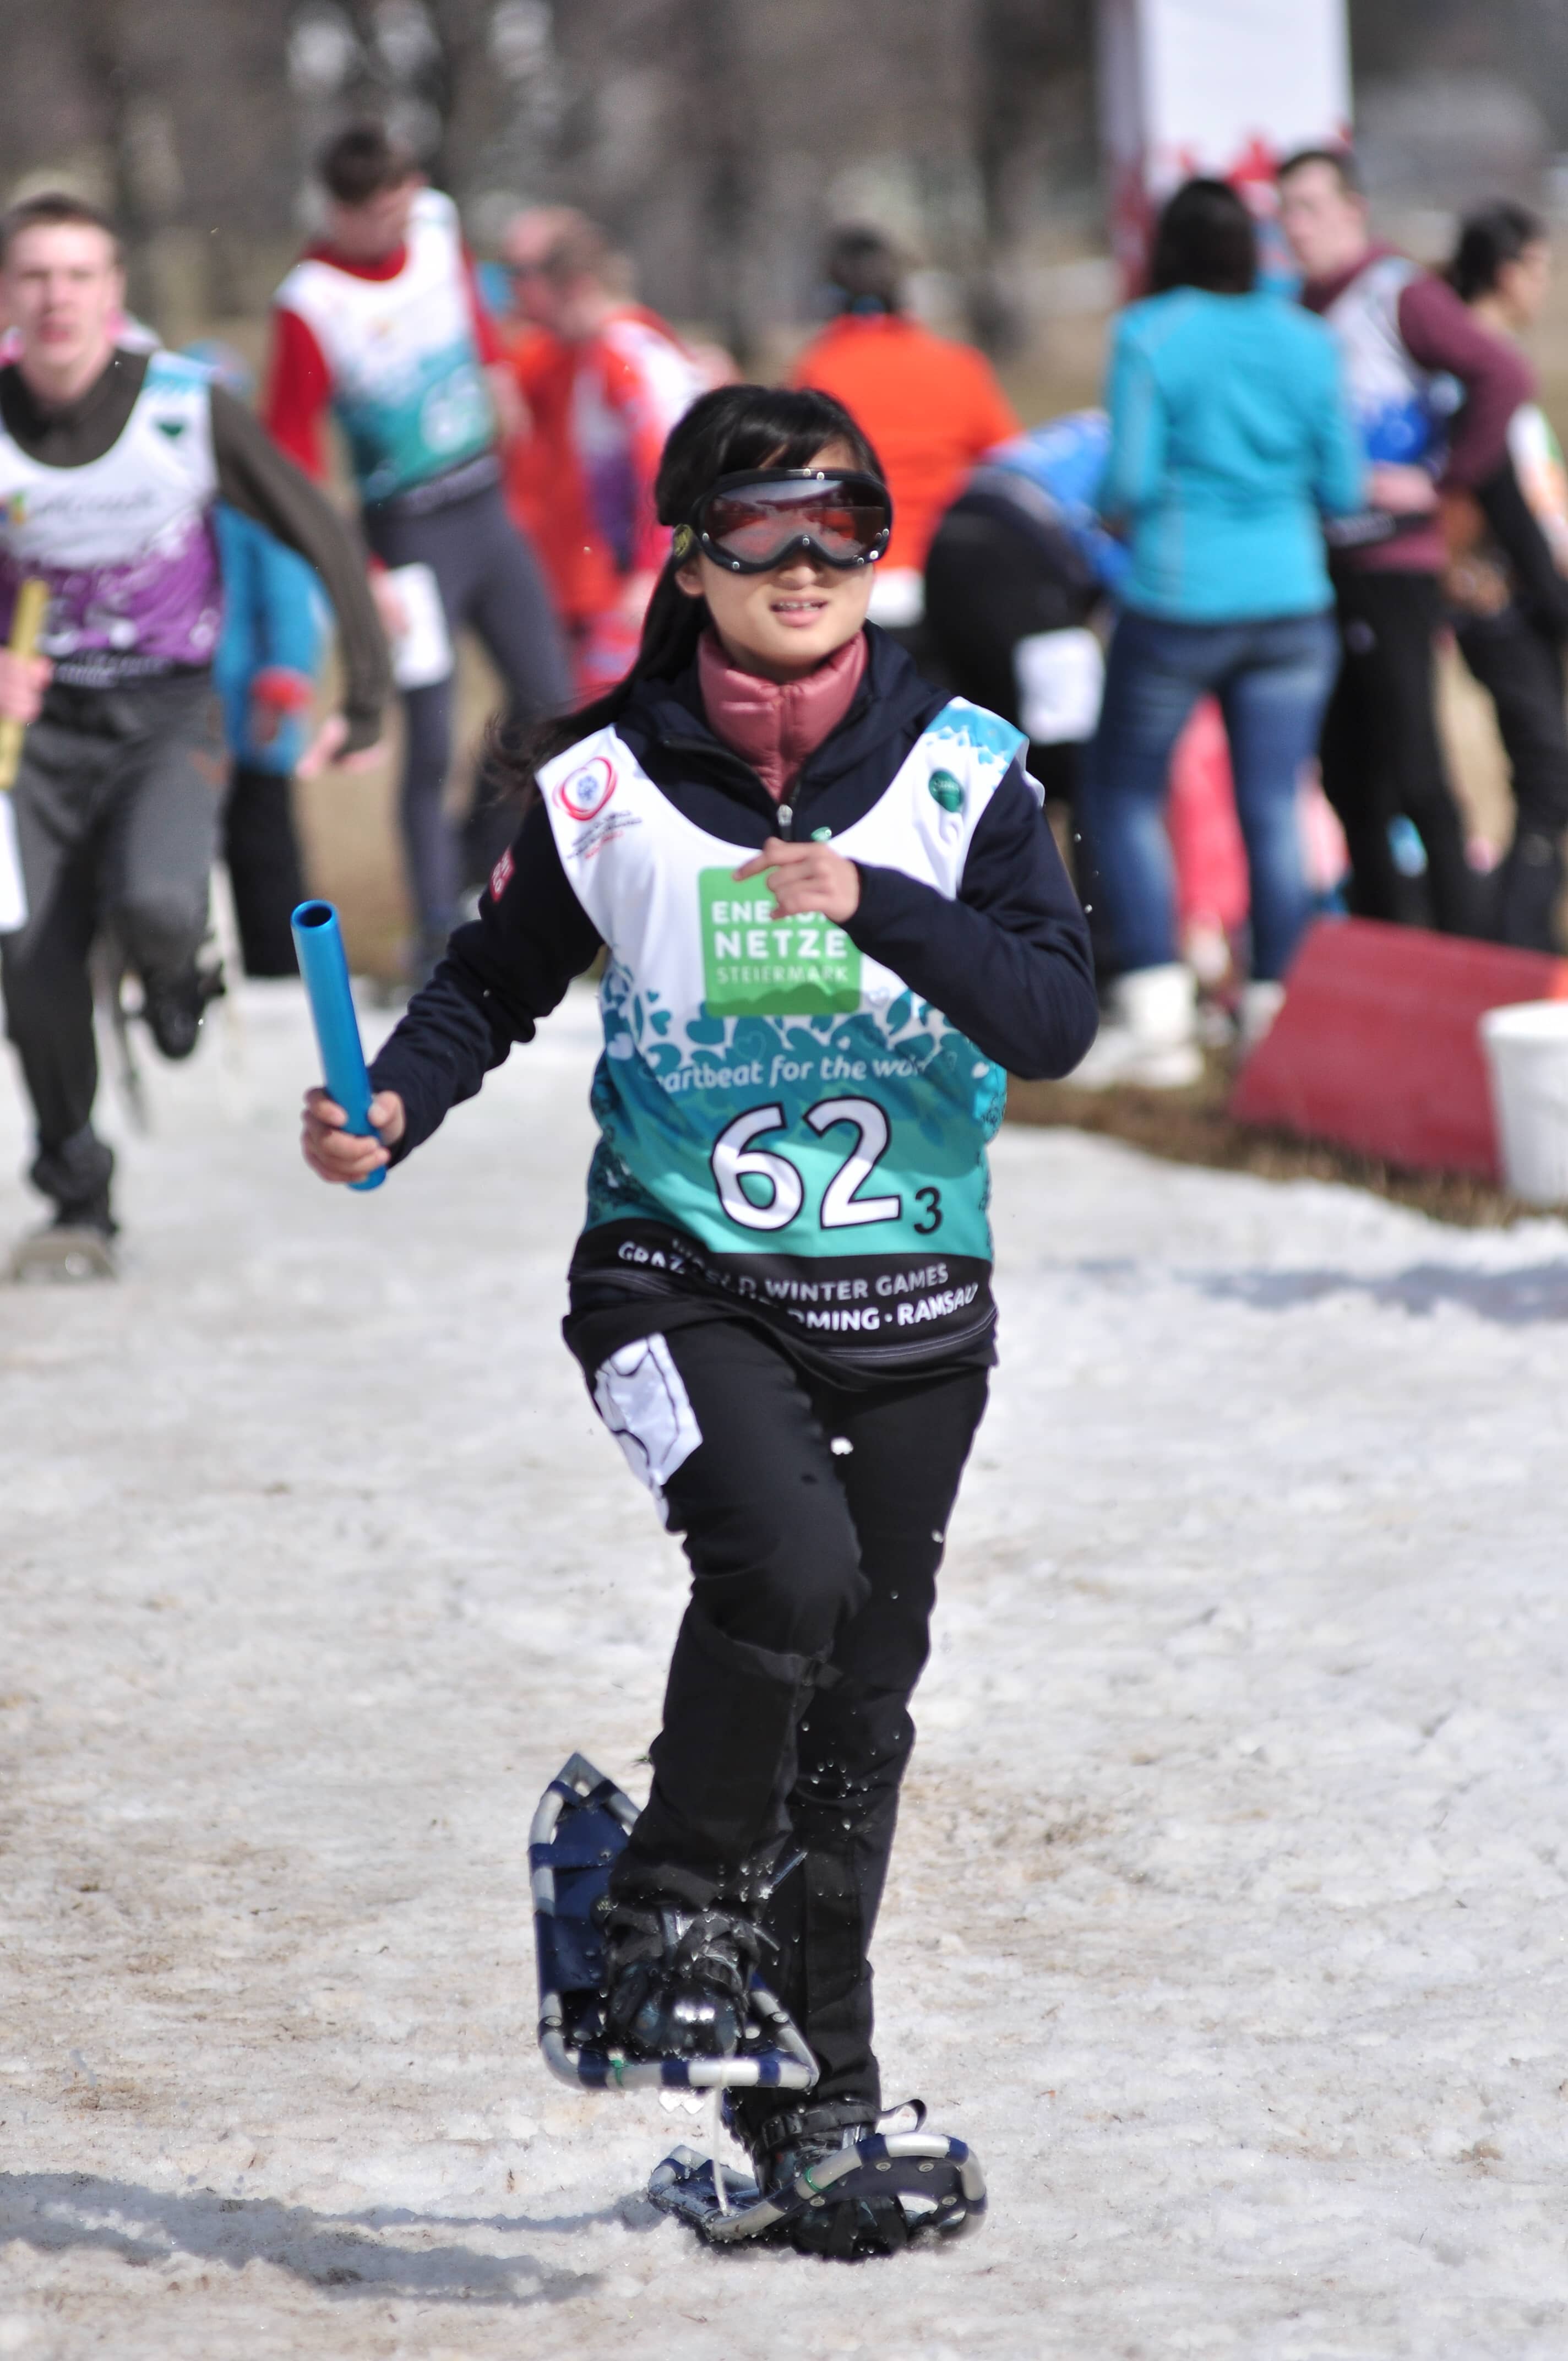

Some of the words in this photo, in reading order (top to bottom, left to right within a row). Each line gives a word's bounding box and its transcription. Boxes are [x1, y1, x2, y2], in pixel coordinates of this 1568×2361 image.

[714, 928, 848, 959] NETZE
[716, 965, 849, 984] STEIERMARK
[656, 1059, 764, 1094] artbeat
[769, 1054, 814, 1089] for
[820, 1054, 867, 1081] the
[710, 1095, 902, 1231] 62
[913, 1187, 942, 1235] 3
[765, 1279, 869, 1302] WINTER
[875, 1263, 949, 1297] GAMES
[897, 1282, 979, 1326] RAMSAU
